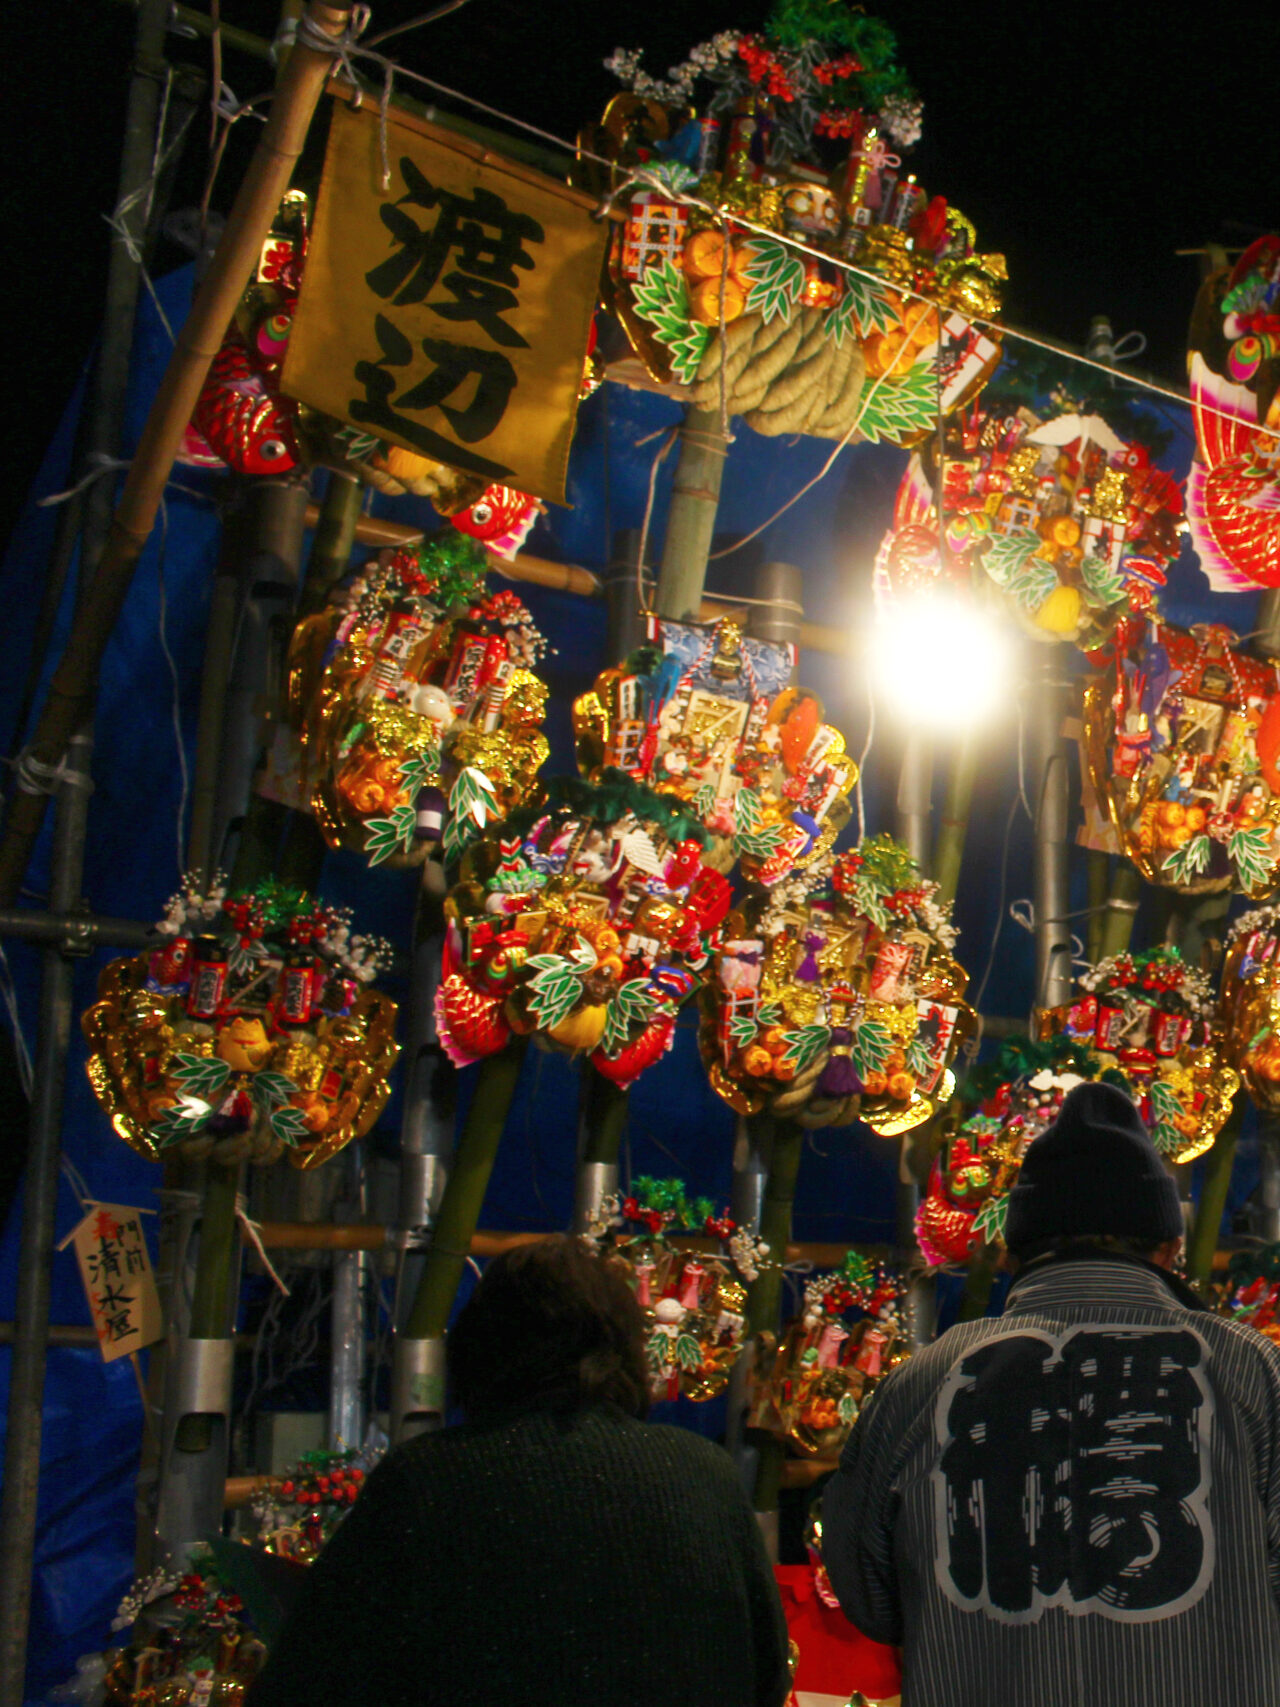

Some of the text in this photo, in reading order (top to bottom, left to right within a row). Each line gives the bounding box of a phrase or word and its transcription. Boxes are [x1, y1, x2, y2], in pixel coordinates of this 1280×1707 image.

[348, 156, 546, 479] 渡辺
[86, 1236, 139, 1342] 清水屋
